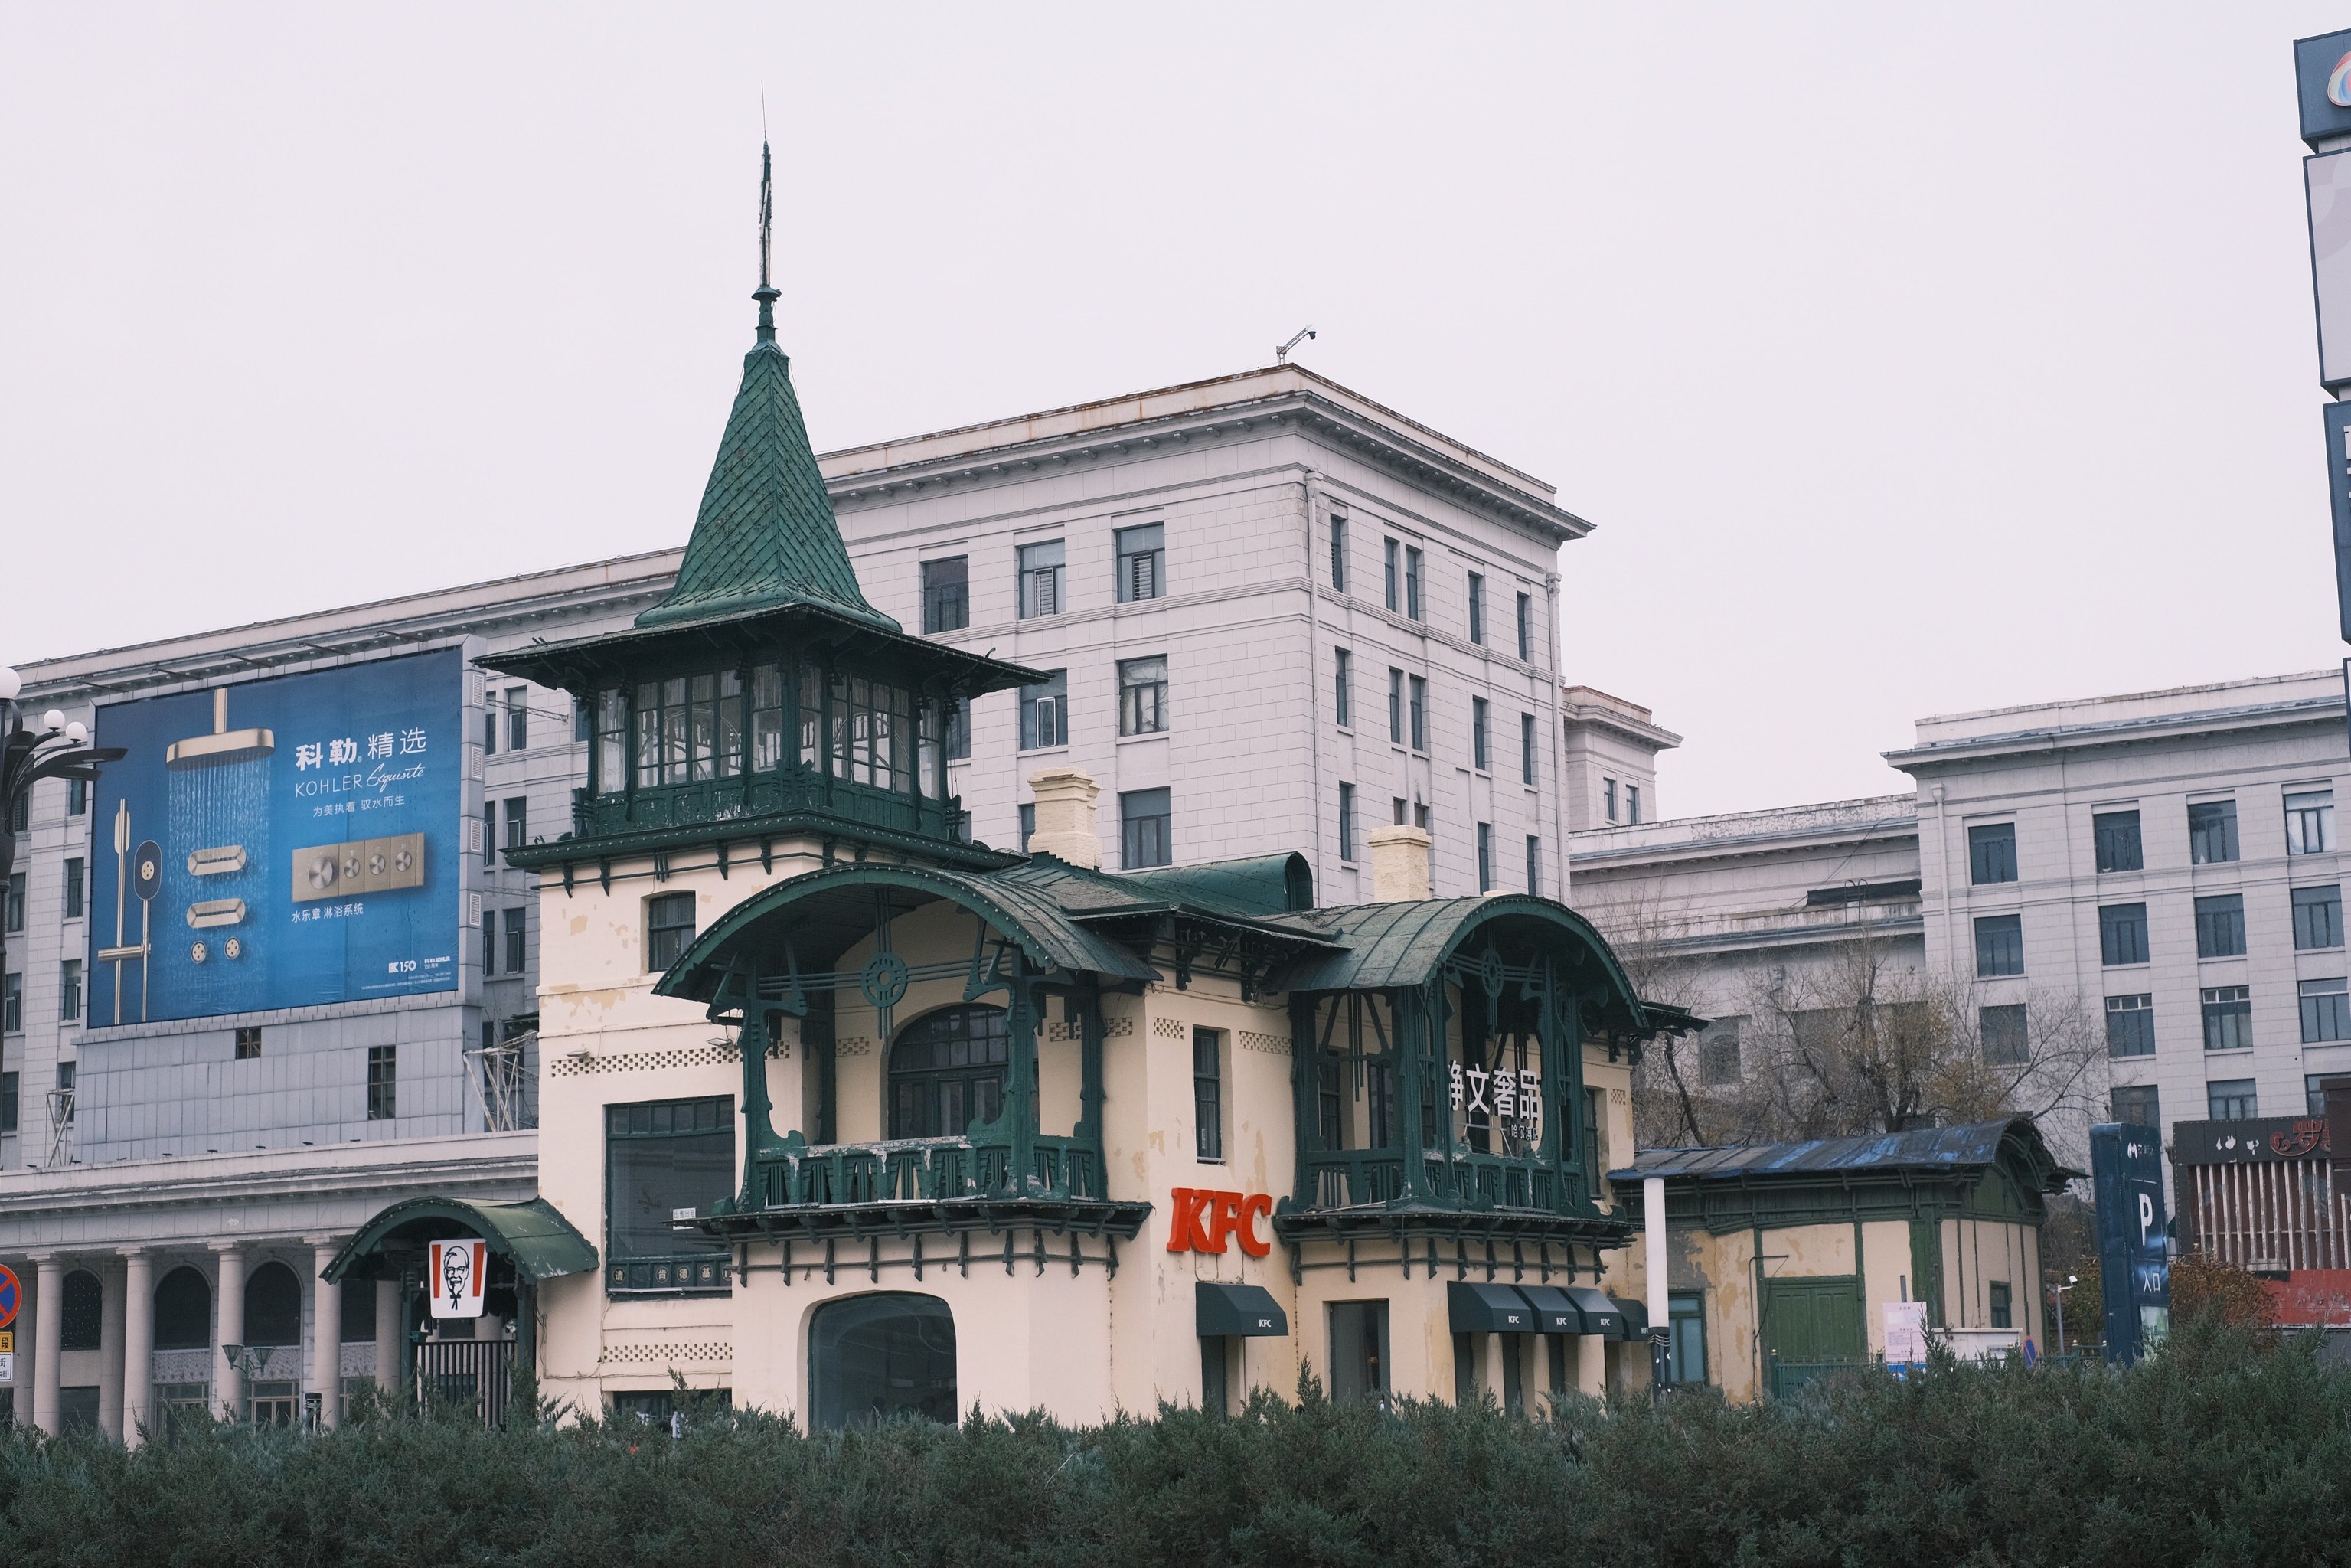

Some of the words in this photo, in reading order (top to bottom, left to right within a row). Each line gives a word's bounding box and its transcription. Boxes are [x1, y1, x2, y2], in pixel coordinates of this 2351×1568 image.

[367, 727, 426, 760] 精选
[296, 774, 363, 798] KOHLER
[366, 763, 426, 793] Exquisite
[313, 801, 356, 818] 为美执着
[361, 794, 405, 811] 驭水而生
[292, 908, 321, 923] 水乐章
[324, 902, 364, 919] 淋浴系统
[1167, 1187, 1272, 1257] KFC
[2139, 1193, 2153, 1246] P
[2143, 1270, 2161, 1292] 入口
[1259, 1319, 1272, 1328] KFC
[1508, 1315, 1520, 1324] KFC
[1556, 1317, 1567, 1325] KFC
